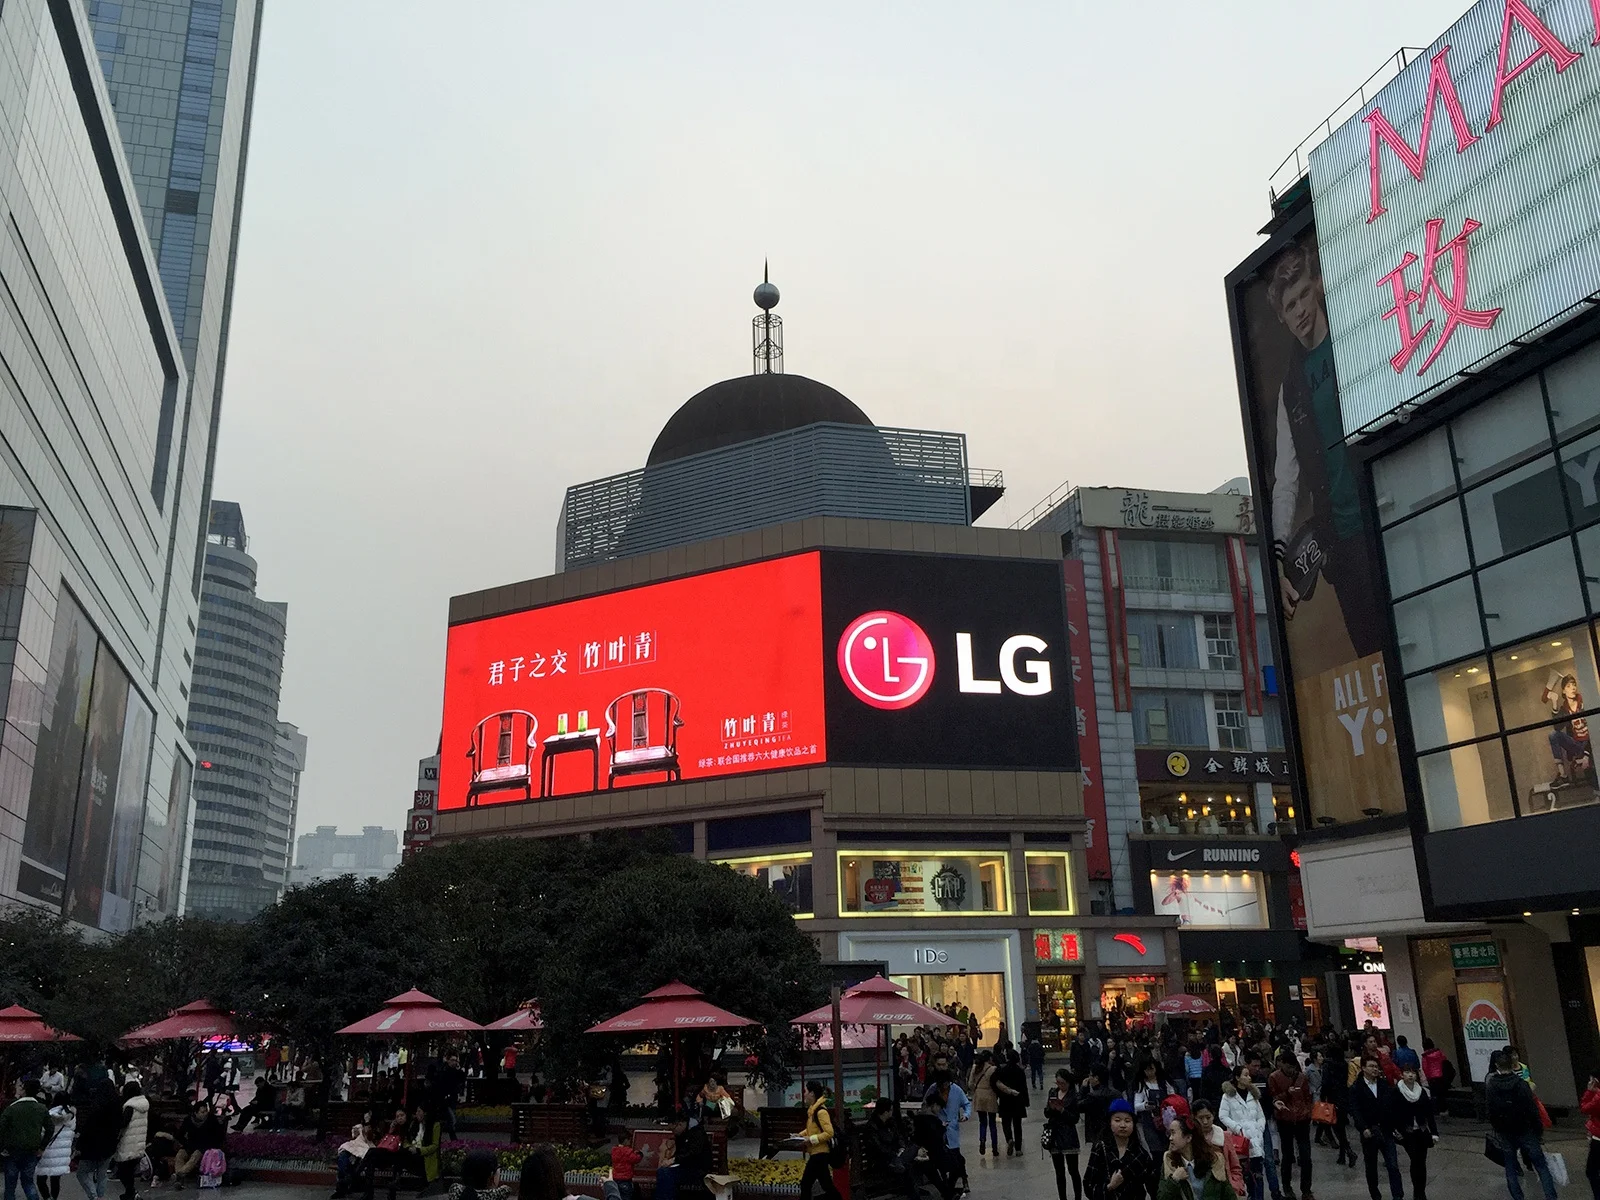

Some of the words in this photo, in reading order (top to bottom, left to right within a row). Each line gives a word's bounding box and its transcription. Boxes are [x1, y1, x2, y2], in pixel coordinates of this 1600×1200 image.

[1362, 0, 1600, 224] MA
[1376, 217, 1504, 377] 玫
[487, 648, 568, 687] 君子之交
[583, 631, 653, 670] 竹叶青
[955, 631, 1053, 697] LG
[1333, 669, 1369, 711] ALL
[724, 711, 776, 738] 竹叶青
[1337, 704, 1397, 757] Y:
[1203, 848, 1260, 862] RUNNING
[934, 876, 961, 899] GAP
